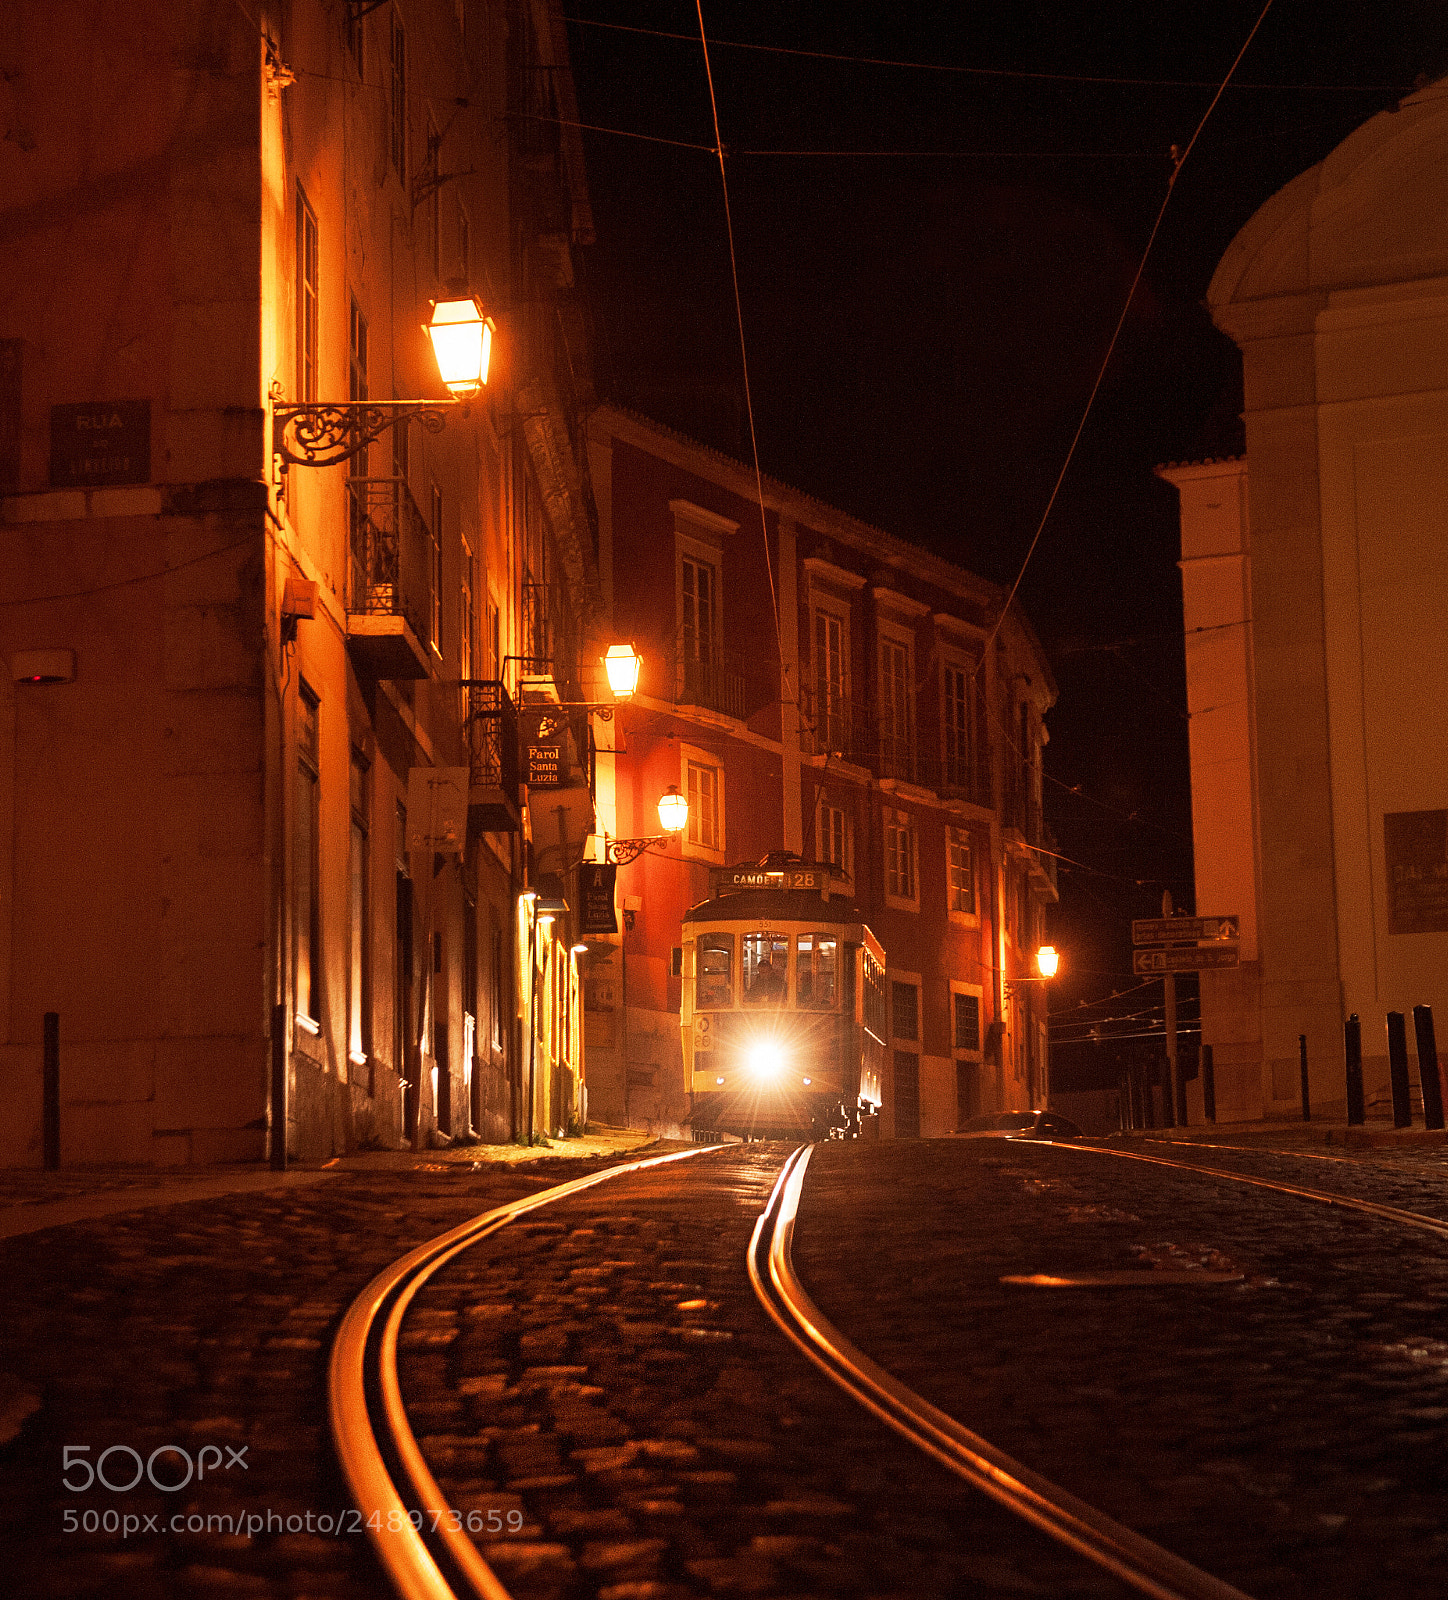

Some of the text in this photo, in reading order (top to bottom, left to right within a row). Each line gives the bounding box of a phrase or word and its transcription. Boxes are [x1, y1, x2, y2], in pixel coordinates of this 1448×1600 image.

[76, 412, 124, 430] RUA
[528, 748, 560, 759] Farol
[529, 761, 558, 771] Santa
[529, 771, 558, 782] Luzia
[794, 873, 815, 887] 28
